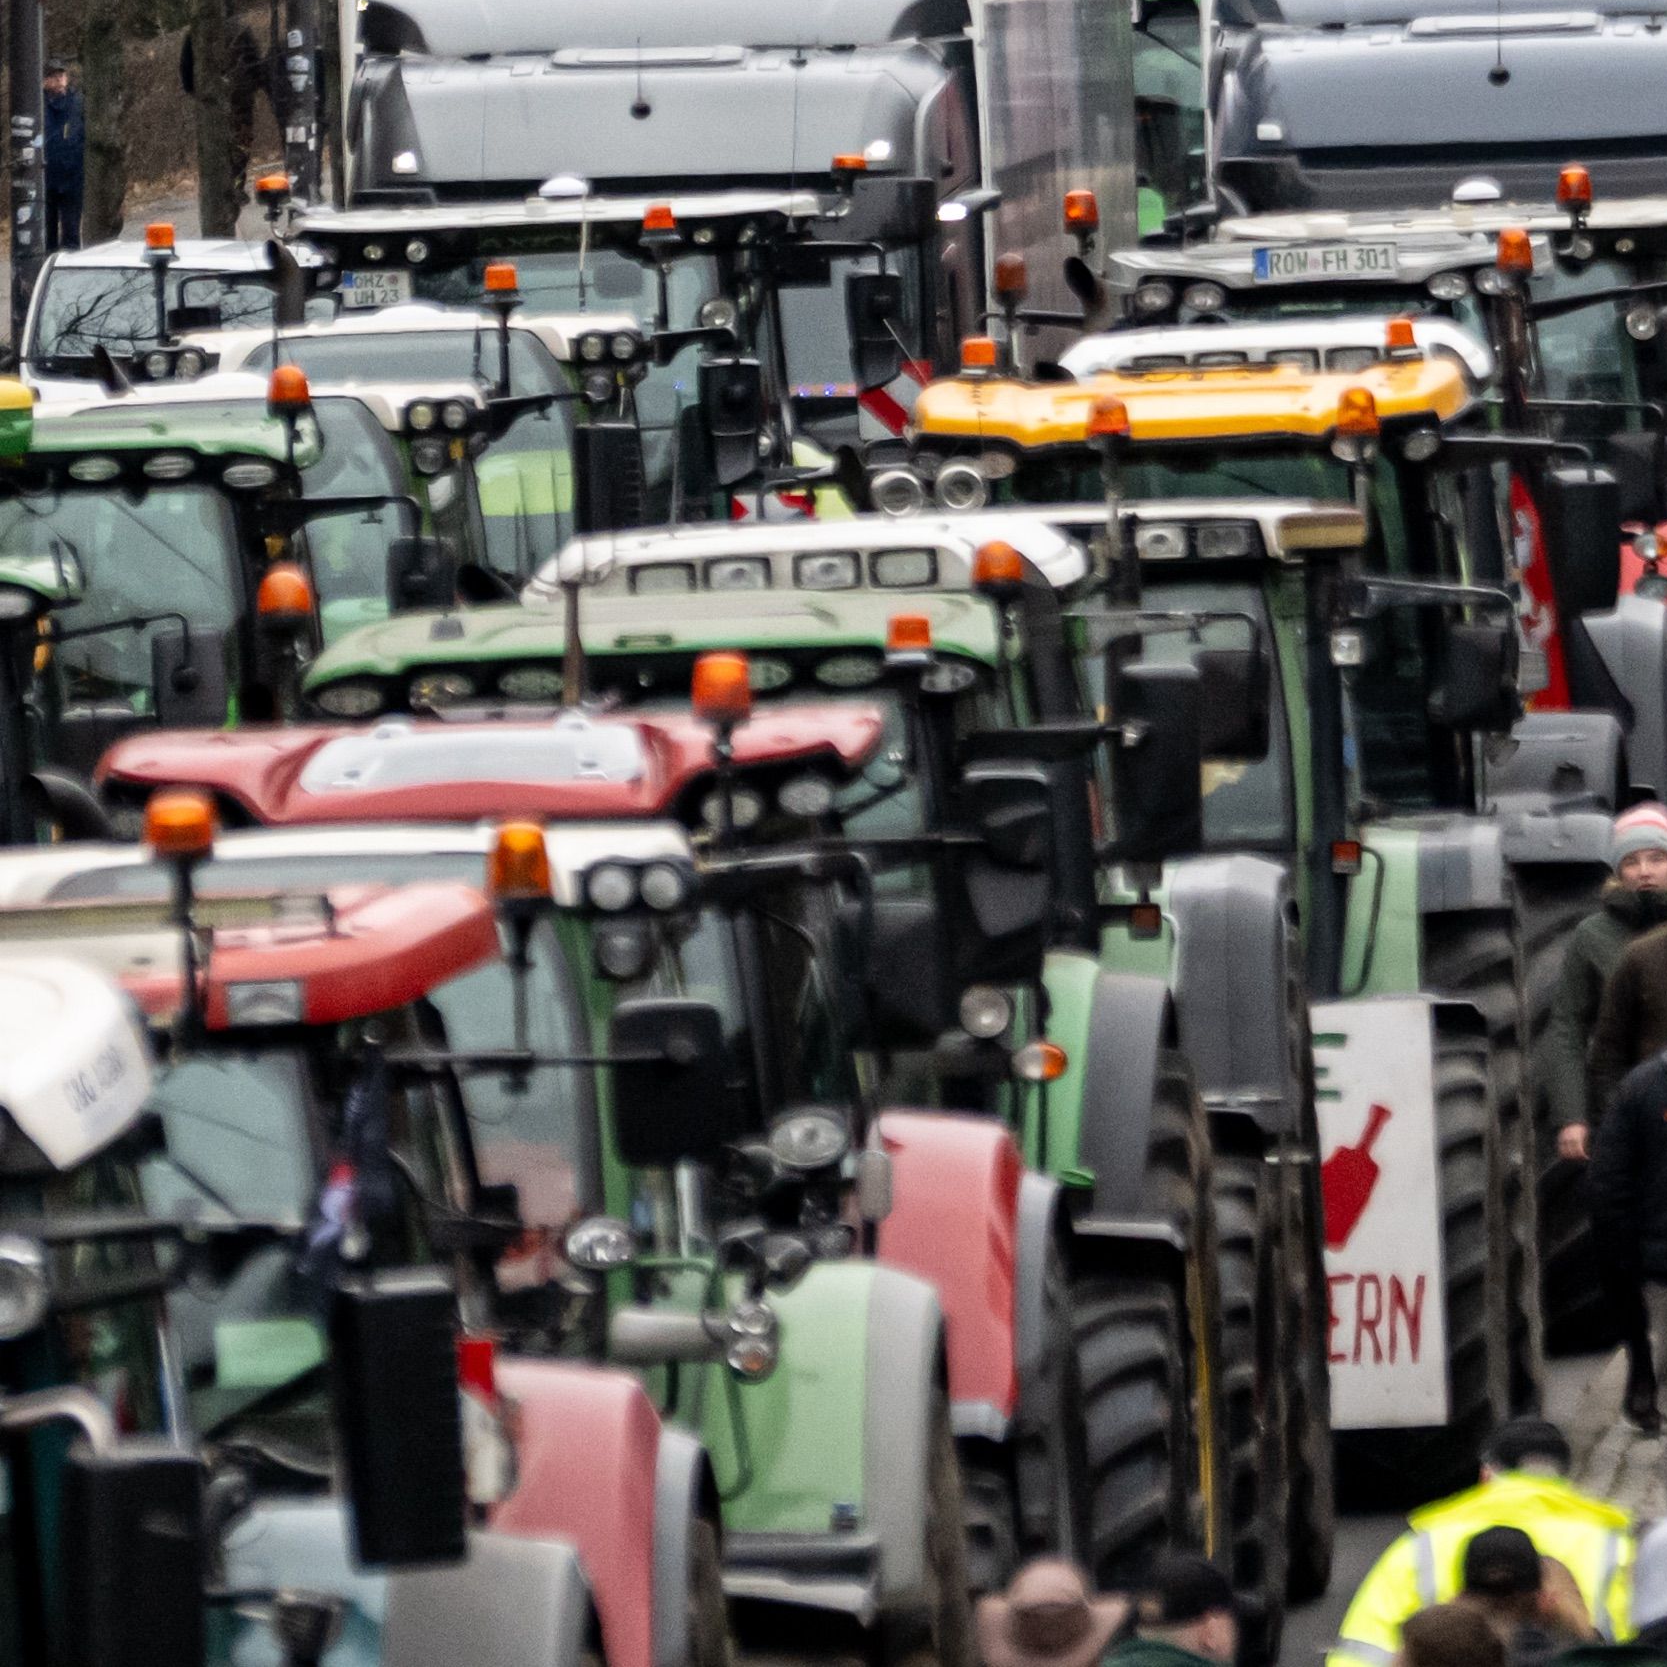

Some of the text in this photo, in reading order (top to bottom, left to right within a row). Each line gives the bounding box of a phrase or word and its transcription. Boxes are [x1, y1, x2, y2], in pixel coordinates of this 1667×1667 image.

[1270, 247, 1392, 274] ROW FH 301
